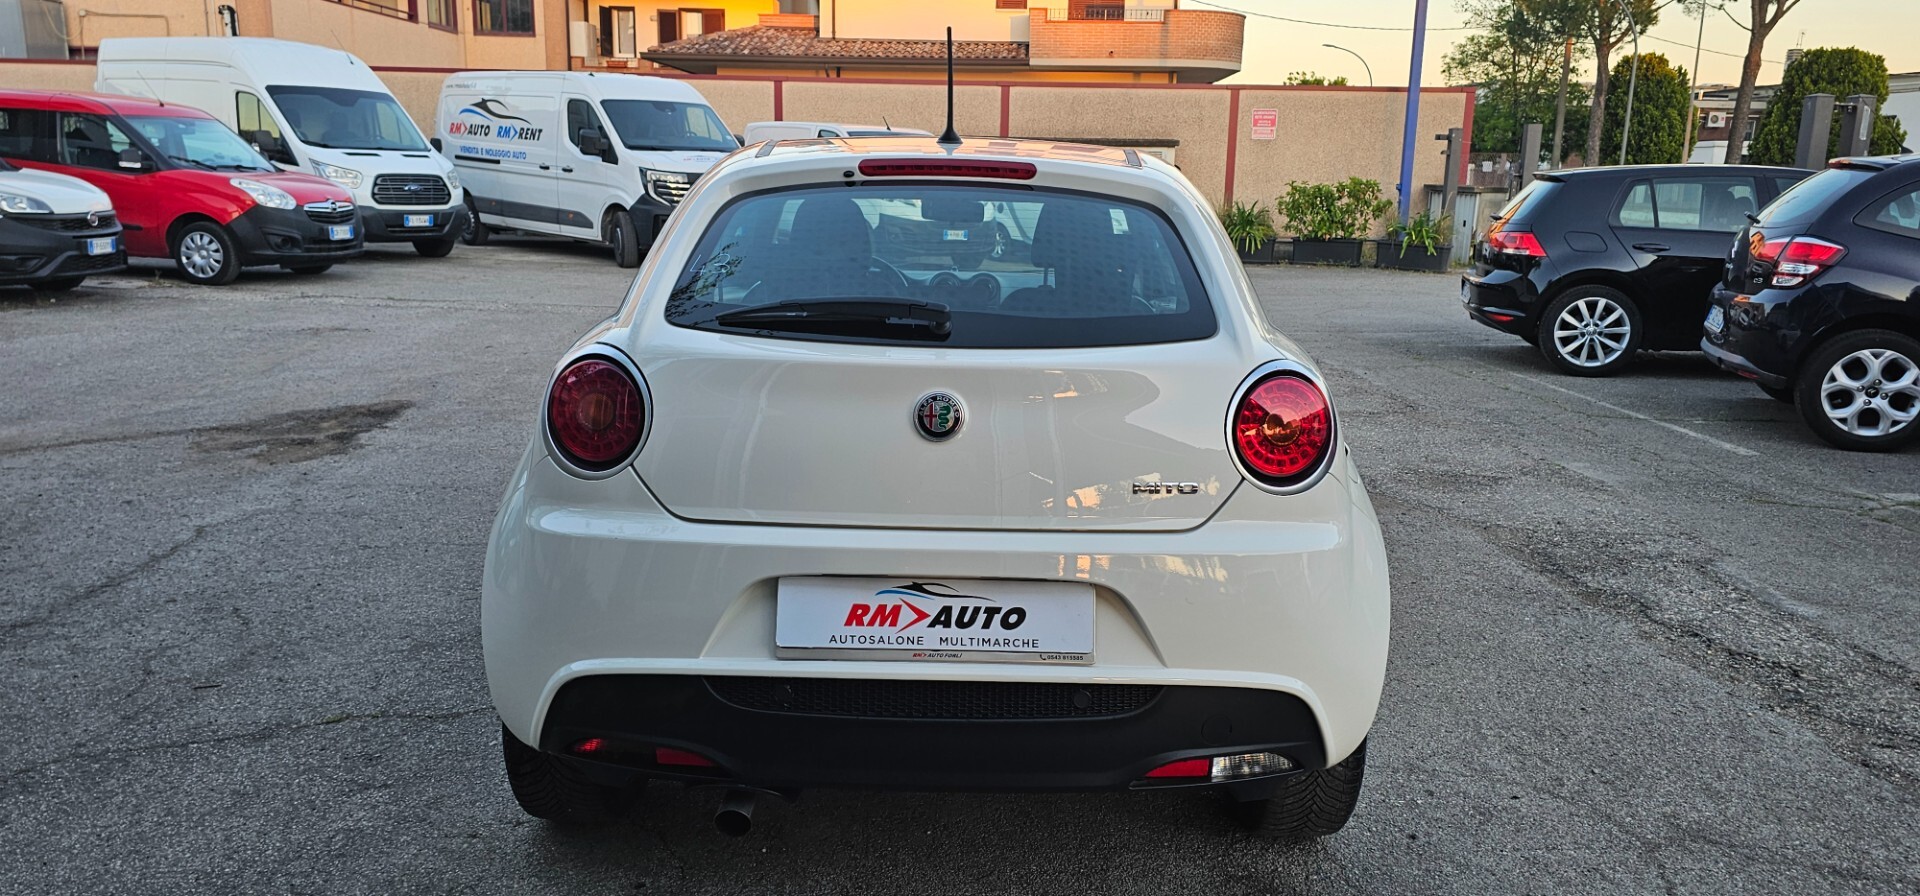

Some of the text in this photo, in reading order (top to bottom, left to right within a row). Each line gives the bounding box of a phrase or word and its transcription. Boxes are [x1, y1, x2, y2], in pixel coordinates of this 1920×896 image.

[467, 124, 490, 136] AUTO
[518, 127, 543, 141] RENT
[460, 145, 527, 161] VENDITA E NOLEGGIO AUTO
[936, 395, 960, 418] ROMEO
[1132, 482, 1199, 495] MITO
[927, 606, 1027, 631] AUTO
[828, 634, 1040, 649] AUTOSALONE MULTIMARCHE
